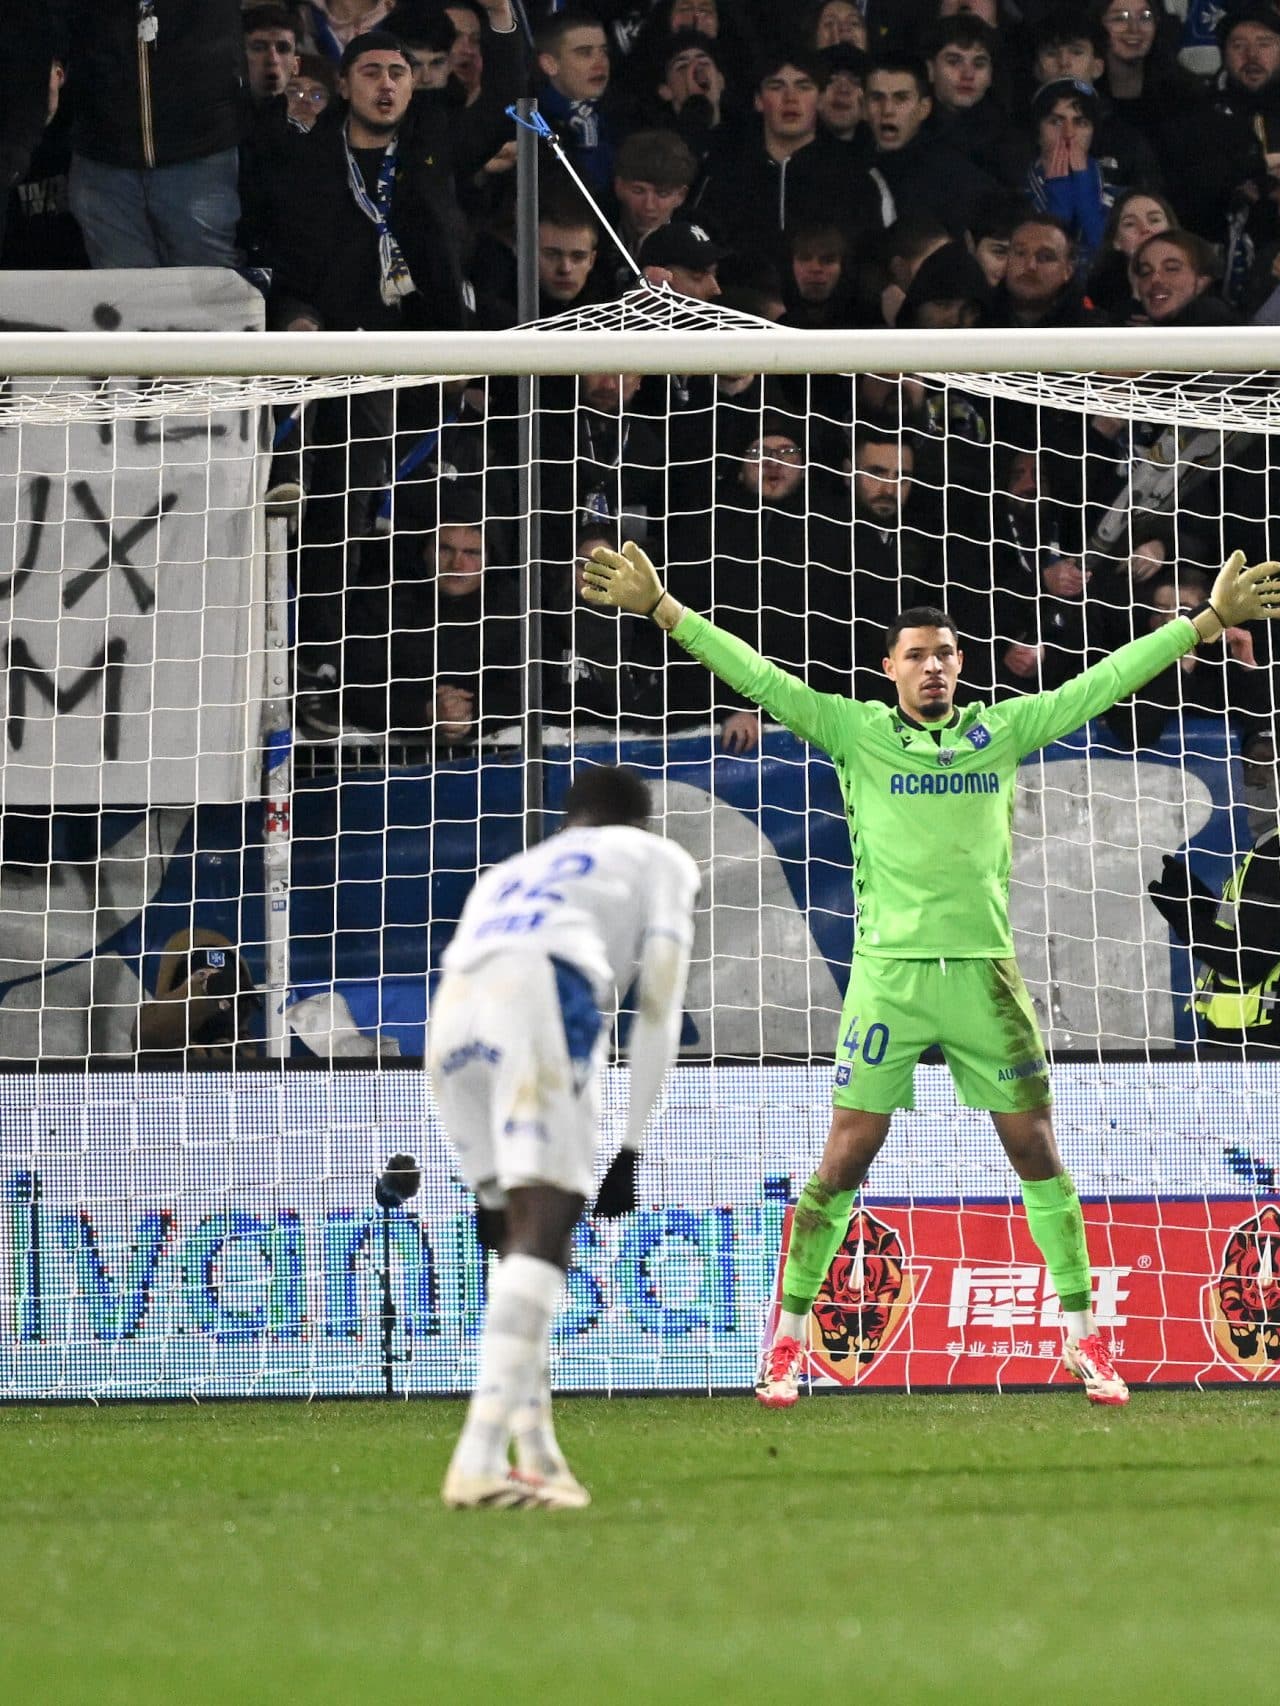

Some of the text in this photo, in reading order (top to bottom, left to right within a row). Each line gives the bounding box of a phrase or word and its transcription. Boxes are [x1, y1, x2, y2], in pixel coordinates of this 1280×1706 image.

[890, 772, 999, 795] ACADOMIA
[842, 1015, 890, 1066] 40
[946, 1340, 1126, 1358] 专业运动营料
